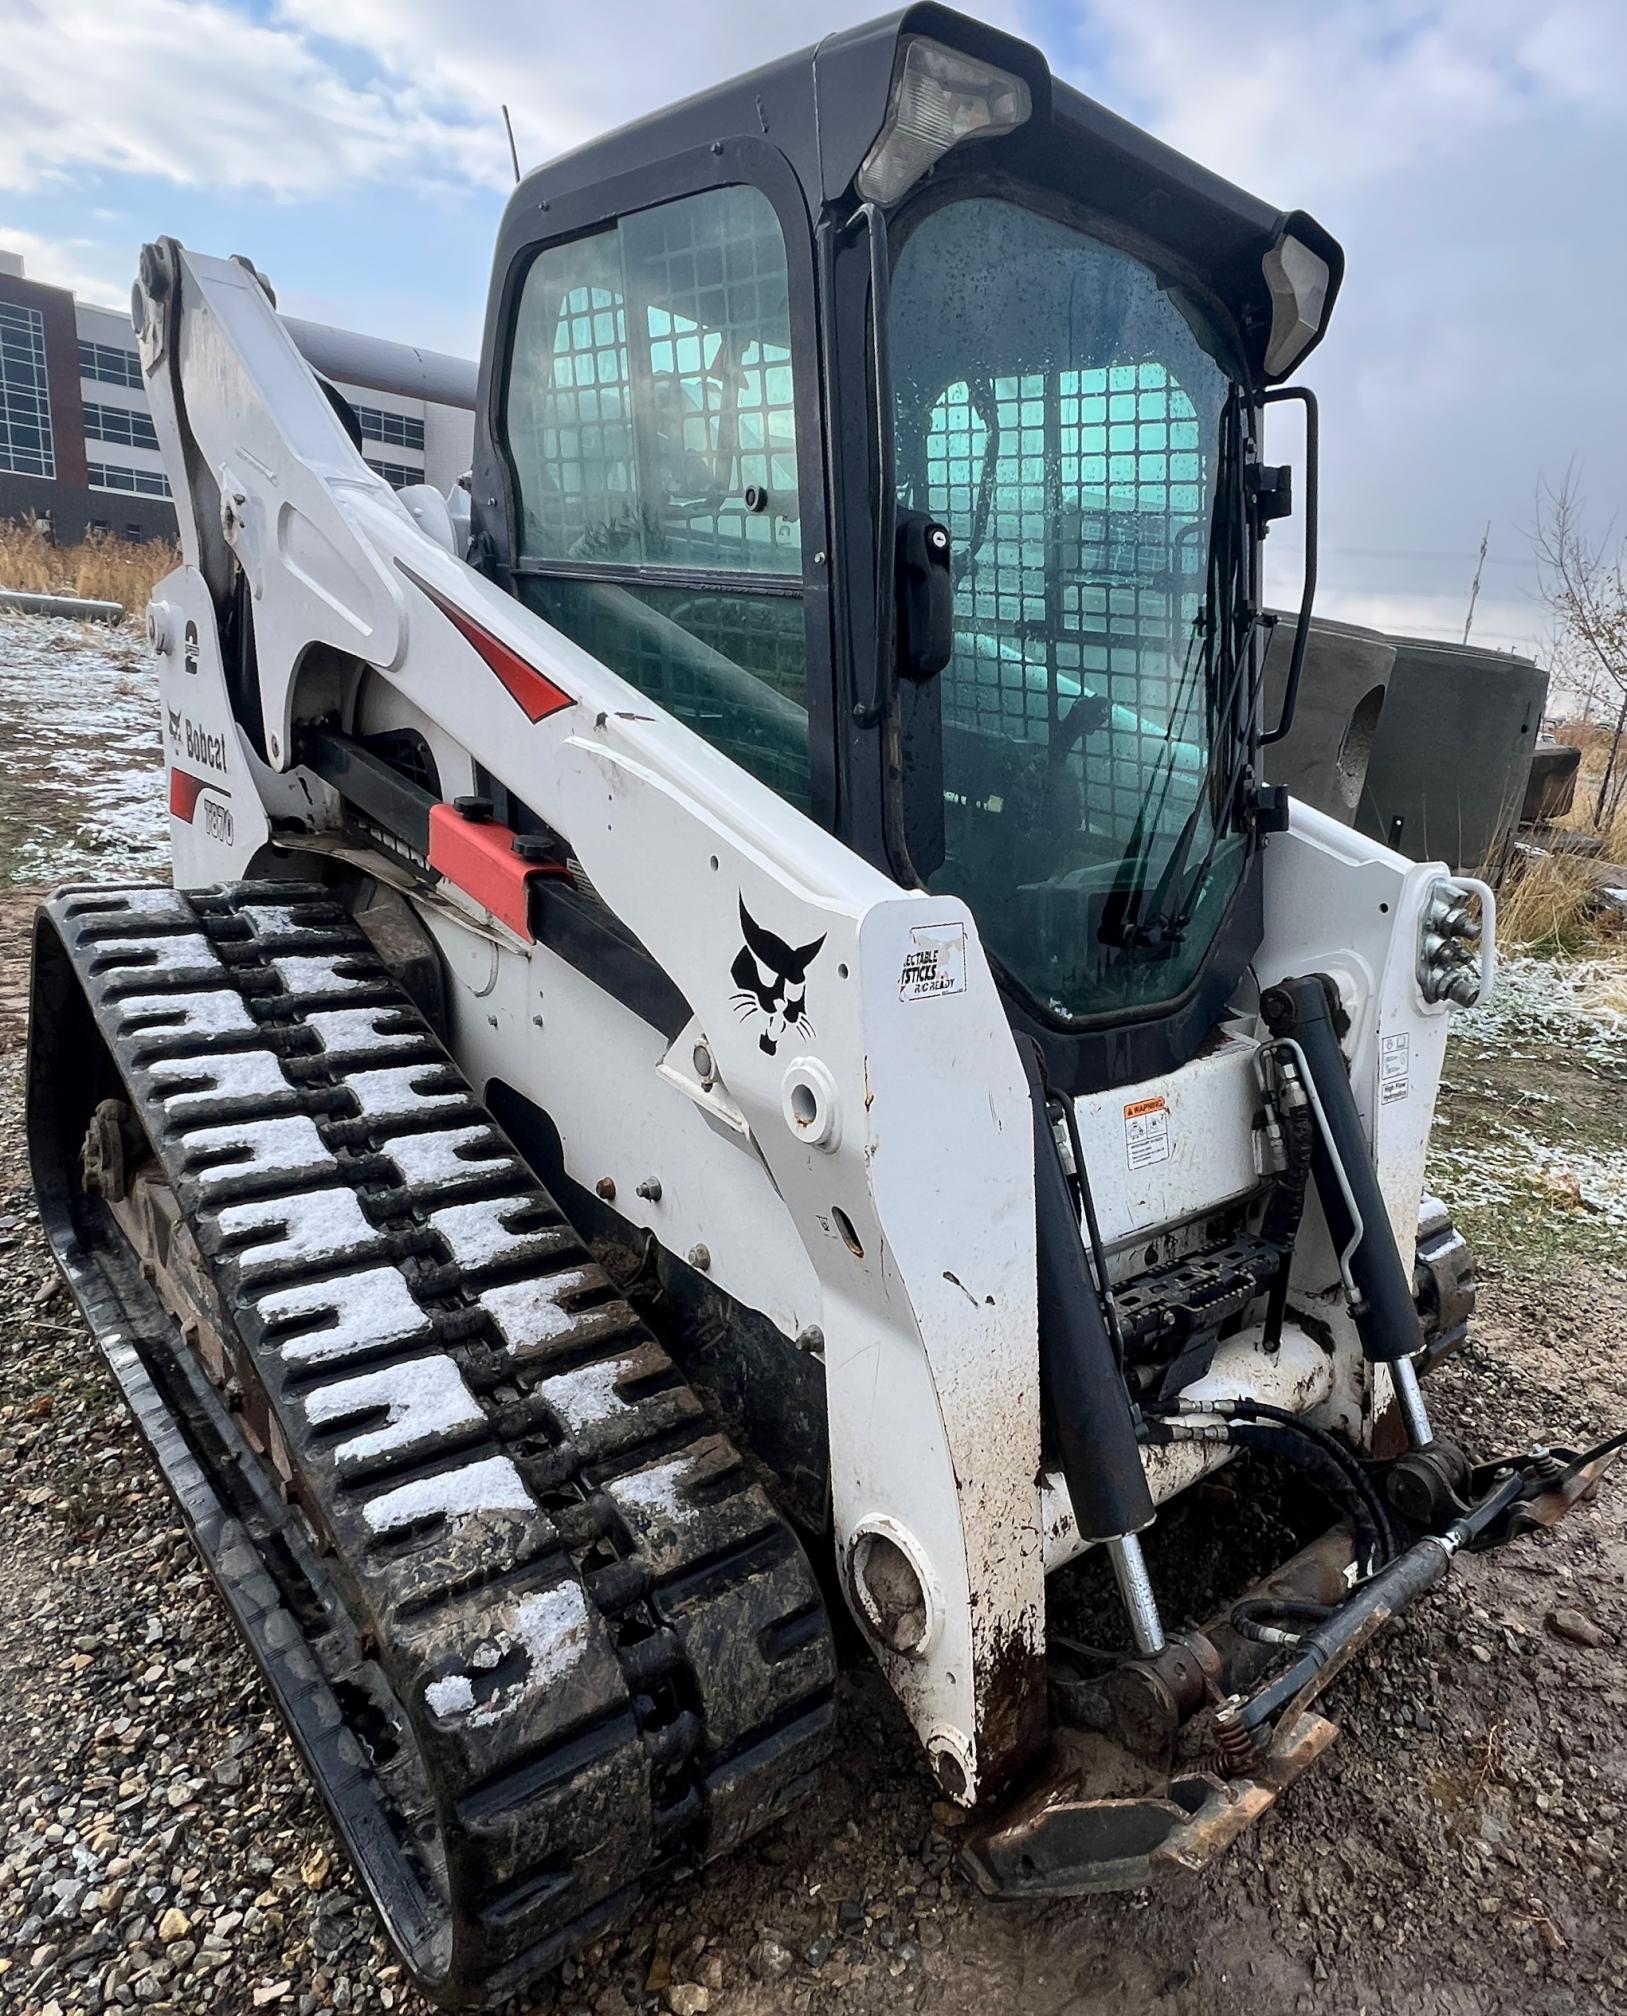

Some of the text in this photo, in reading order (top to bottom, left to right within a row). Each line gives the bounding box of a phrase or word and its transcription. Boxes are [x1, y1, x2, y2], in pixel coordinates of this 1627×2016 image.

[185, 718, 227, 774] Bobcat
[203, 798, 235, 847] T870
[903, 950, 939, 967] ECTABLE
[1134, 1099, 1164, 1114] WARNING
